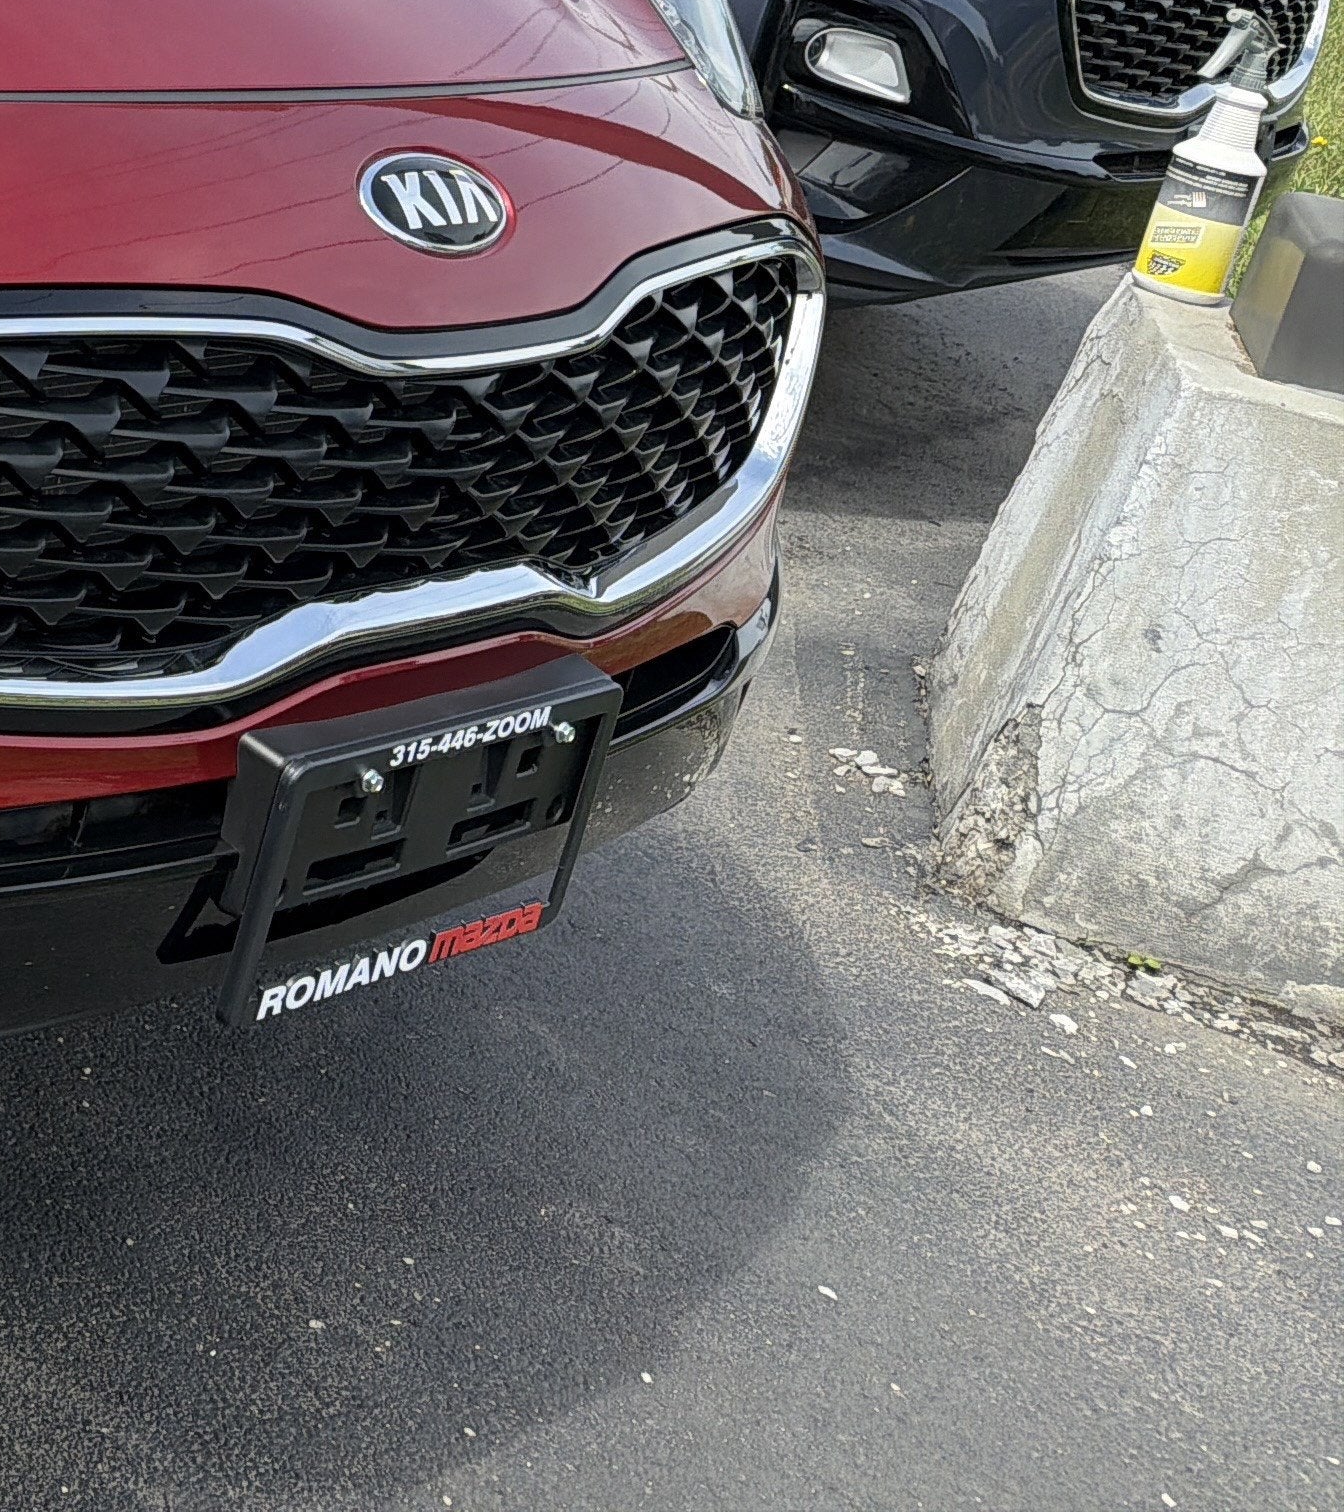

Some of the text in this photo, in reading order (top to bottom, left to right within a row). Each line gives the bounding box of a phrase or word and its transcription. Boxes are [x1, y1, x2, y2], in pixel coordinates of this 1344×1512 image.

[381, 169, 498, 229] KIA
[389, 706, 551, 767] 315-446-ZOOM
[256, 939, 427, 1020] ROMANO
